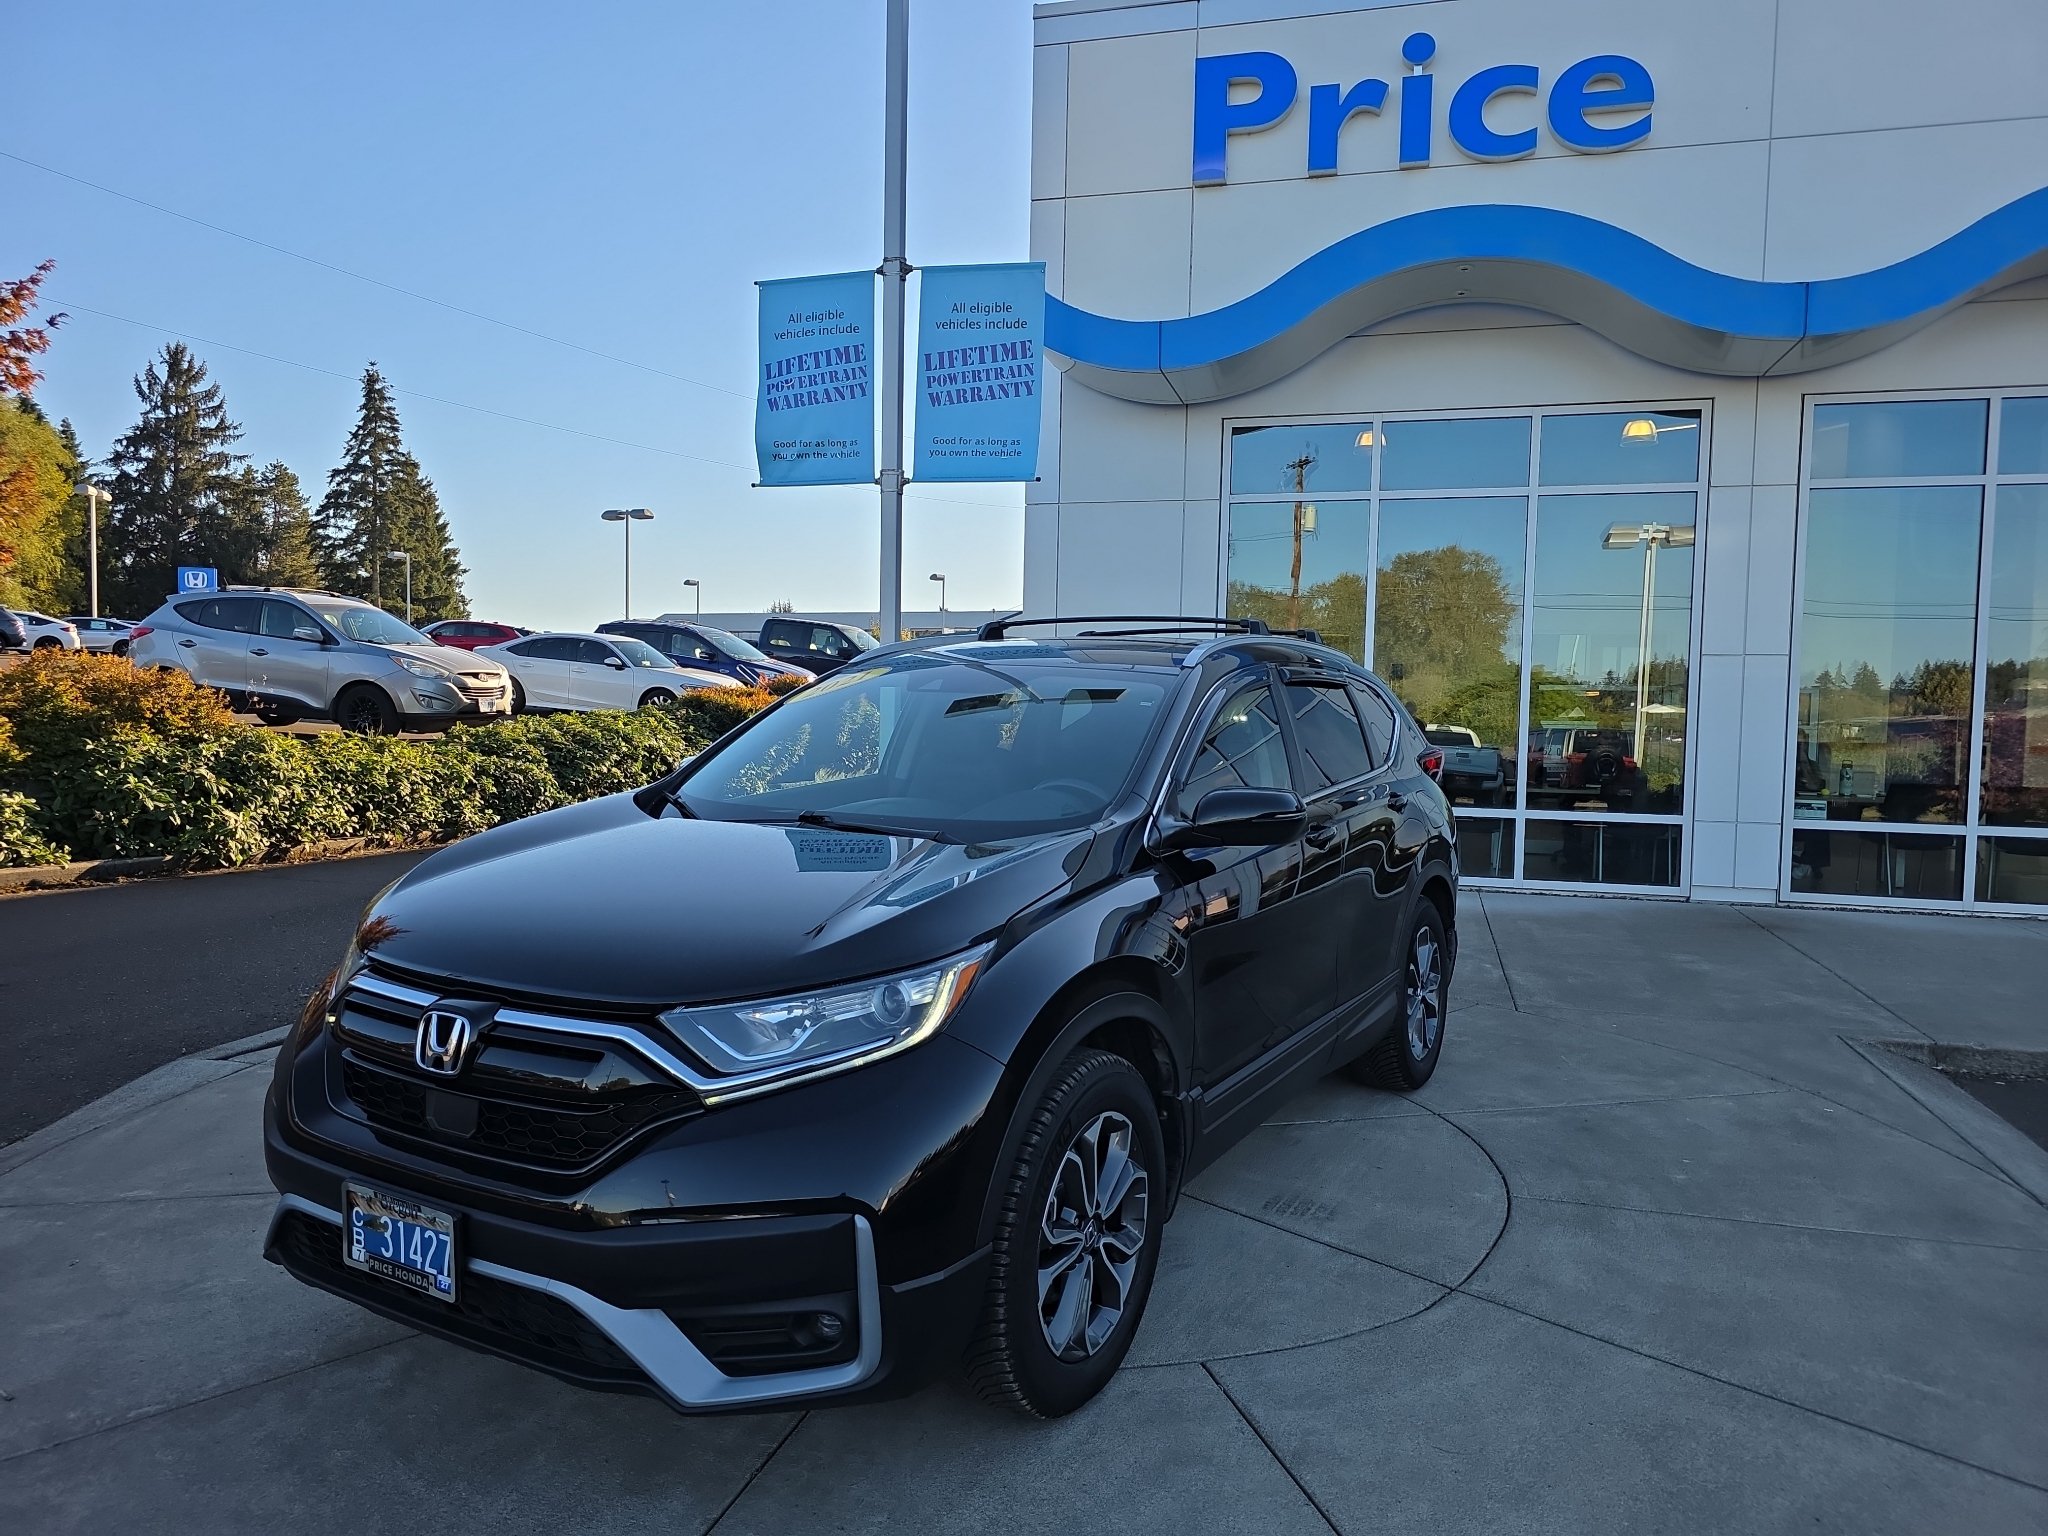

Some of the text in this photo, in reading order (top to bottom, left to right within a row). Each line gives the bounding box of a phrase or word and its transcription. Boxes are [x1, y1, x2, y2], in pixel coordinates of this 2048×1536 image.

[1193, 33, 1655, 186] Price
[788, 309, 845, 324] All eligible
[951, 301, 1013, 316] All eligible
[774, 323, 860, 340] vehicles include
[935, 317, 1028, 330] vehicles include
[765, 343, 867, 380] LIFETIME
[924, 339, 1034, 372] LIFETIME
[766, 365, 868, 395] POWERTRAIN
[926, 362, 1034, 389] POWERTRAIN
[766, 381, 869, 412] WARRANTY
[928, 379, 1035, 408] WARRANTY
[772, 449, 861, 462] you own the vehicle
[773, 440, 797, 449] Good
[799, 440, 812, 448] for
[828, 439, 847, 449] long
[929, 449, 947, 459] you
[971, 448, 987, 457] the
[988, 448, 1022, 457] vehicle
[932, 436, 957, 445] Good
[959, 436, 972, 446] for
[975, 438, 986, 446] as
[987, 436, 1008, 448] long
[380, 1215, 451, 1277] 31427
[369, 1258, 429, 1289] PRICE HONDA
